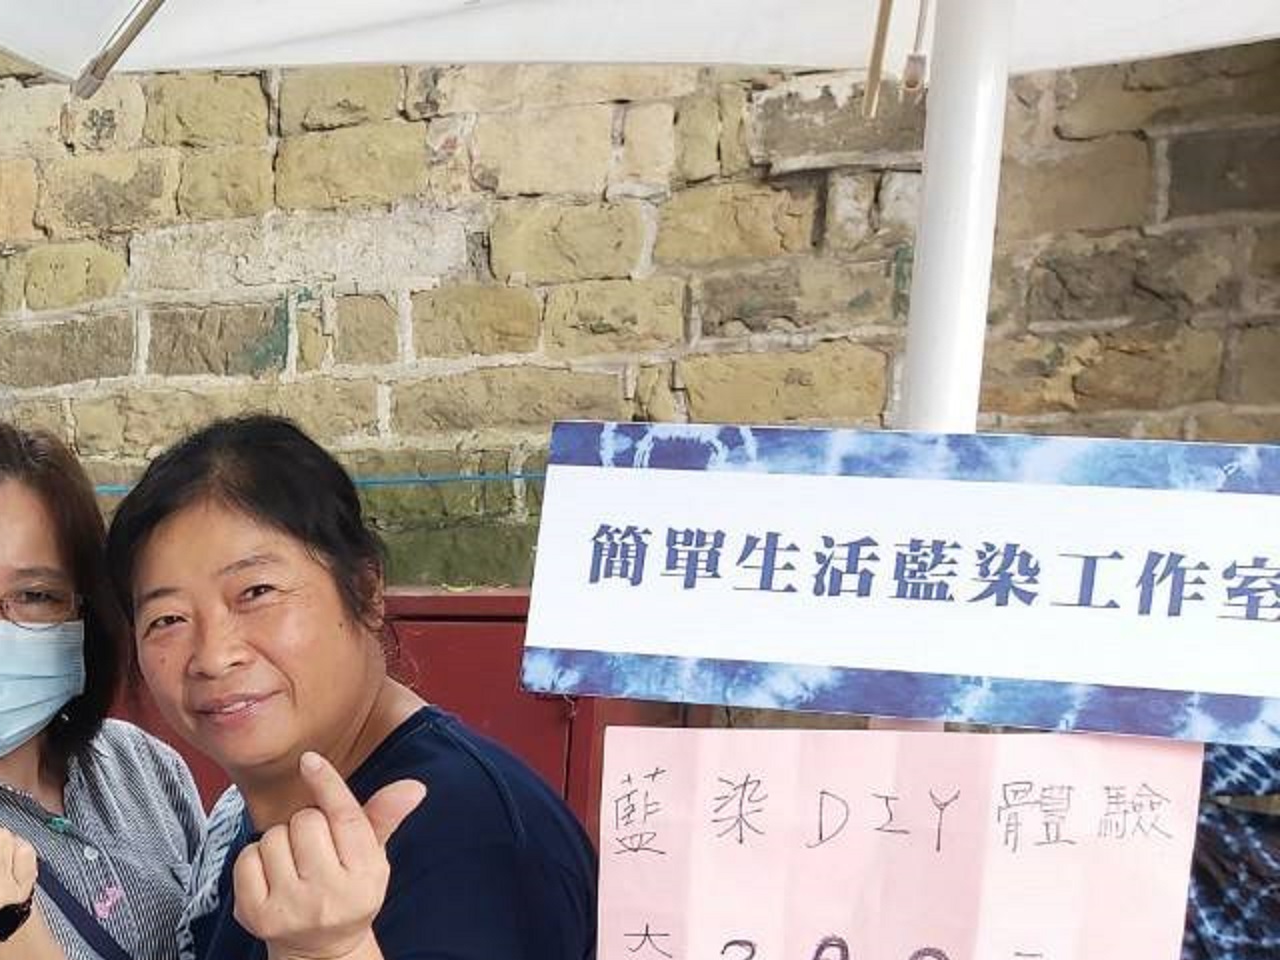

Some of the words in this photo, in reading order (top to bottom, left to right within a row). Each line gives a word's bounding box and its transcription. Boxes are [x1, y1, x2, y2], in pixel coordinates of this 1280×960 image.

[589, 523, 1280, 622] 簡單生活藍染工作室
